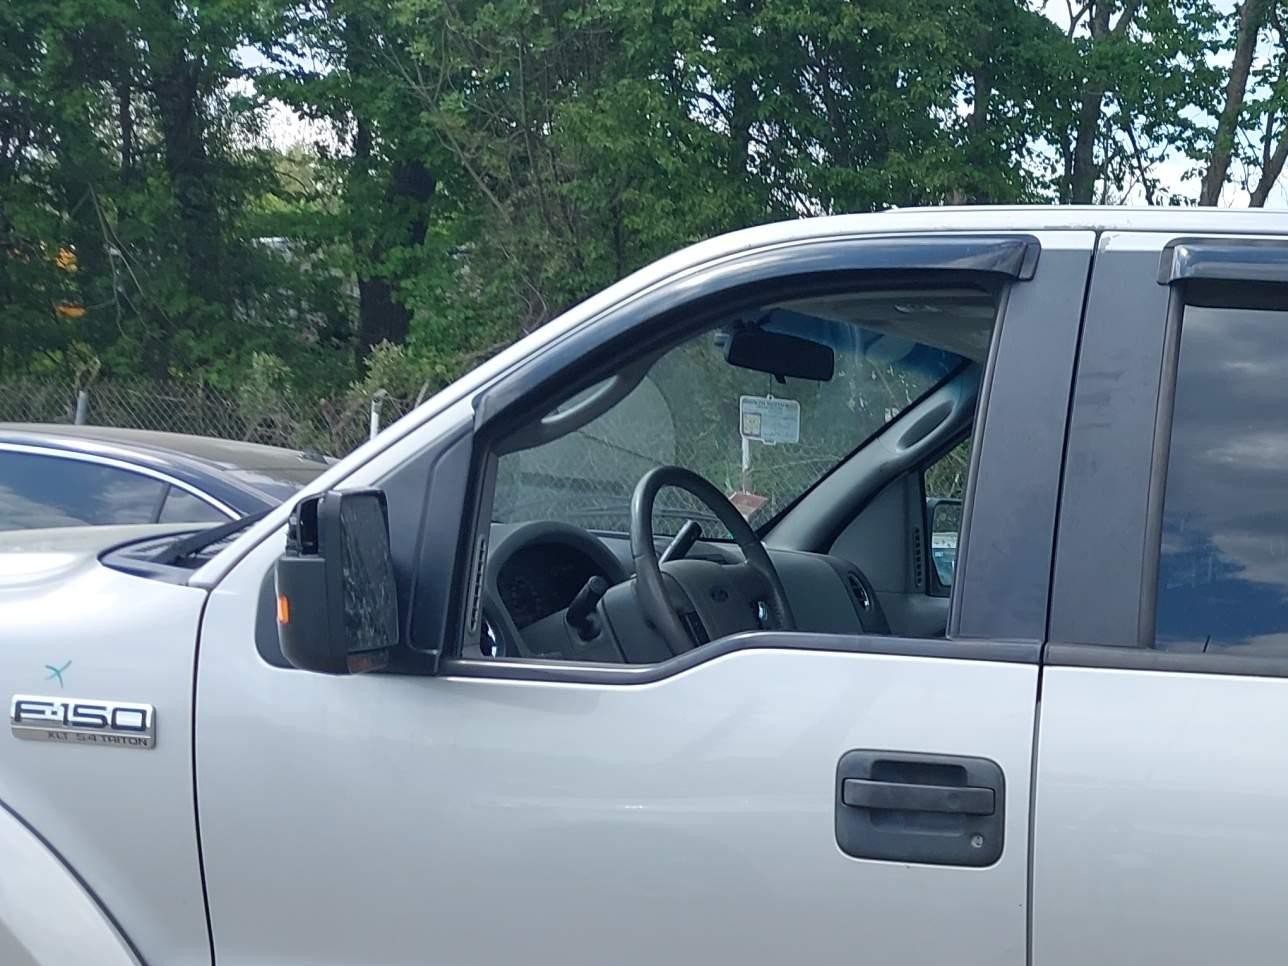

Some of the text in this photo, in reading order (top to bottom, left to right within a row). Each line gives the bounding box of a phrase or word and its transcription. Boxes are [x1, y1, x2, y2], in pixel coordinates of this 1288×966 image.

[14, 699, 147, 732] F-150
[47, 730, 68, 741] XLT
[103, 735, 148, 747] TRITON
